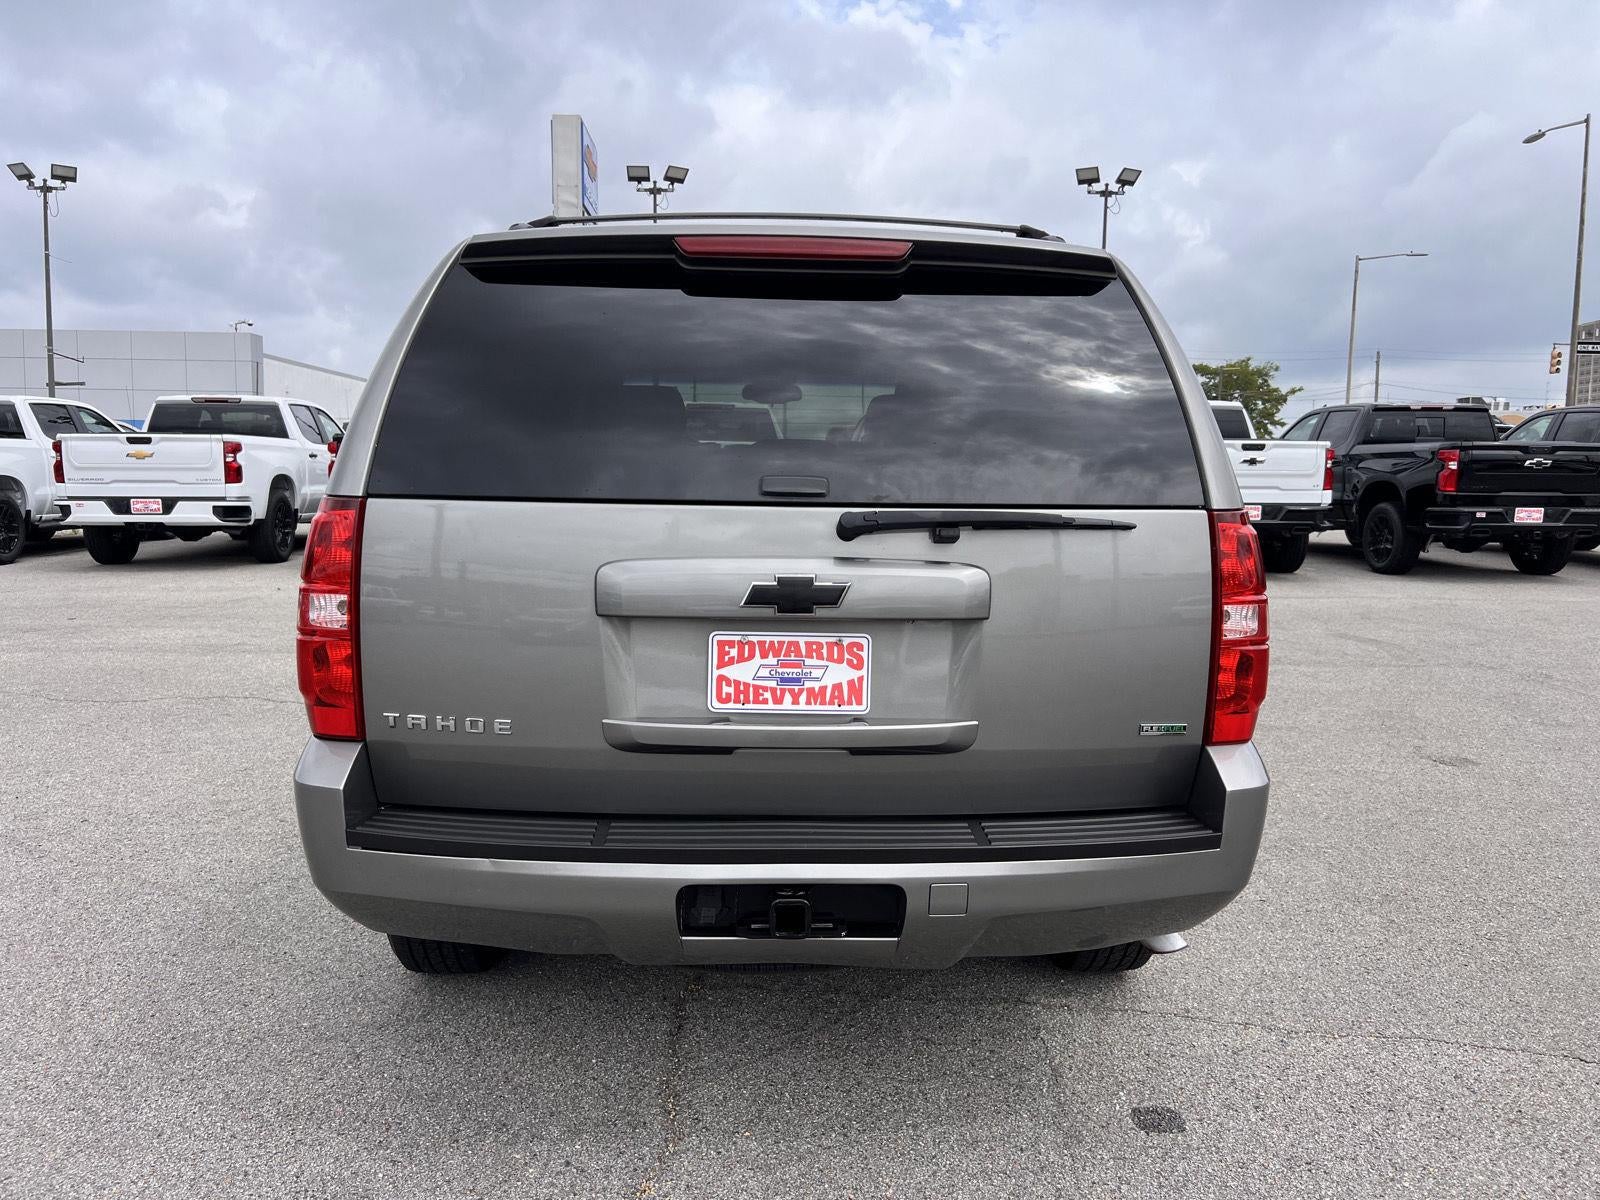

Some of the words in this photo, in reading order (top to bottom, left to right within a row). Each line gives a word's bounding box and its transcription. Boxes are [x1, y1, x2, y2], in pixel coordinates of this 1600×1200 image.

[716, 640, 864, 671] EDWARDS
[769, 669, 812, 677] Chevrolet
[716, 674, 864, 706] CHEVYMAN
[383, 712, 512, 734] TAHOE
